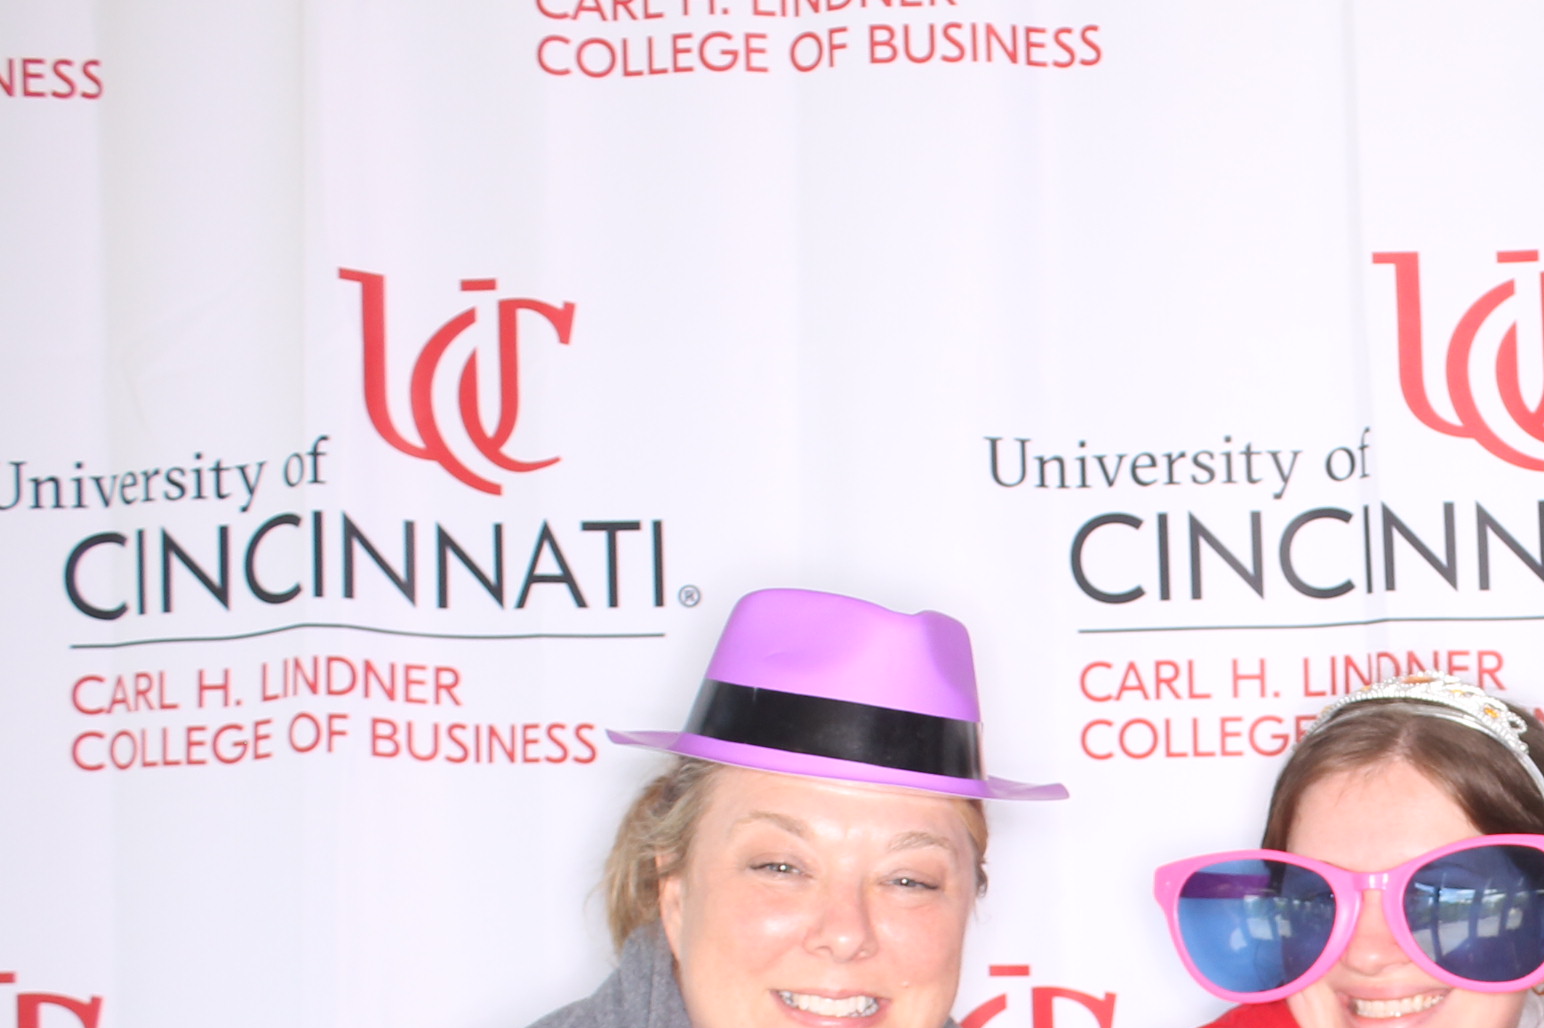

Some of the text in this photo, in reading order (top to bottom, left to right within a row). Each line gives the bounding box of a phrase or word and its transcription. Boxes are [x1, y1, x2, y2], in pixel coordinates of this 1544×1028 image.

[536, 22, 1102, 79] COLLEGE OF BUSINESS
[283, 435, 330, 488] of
[983, 427, 1370, 500] University of
[71, 656, 462, 716] CARL H. LINDNER
[1079, 659, 1212, 702] CARL
[1232, 658, 1281, 698] H.
[71, 712, 598, 773] COLLEGE OF BUSINESS
